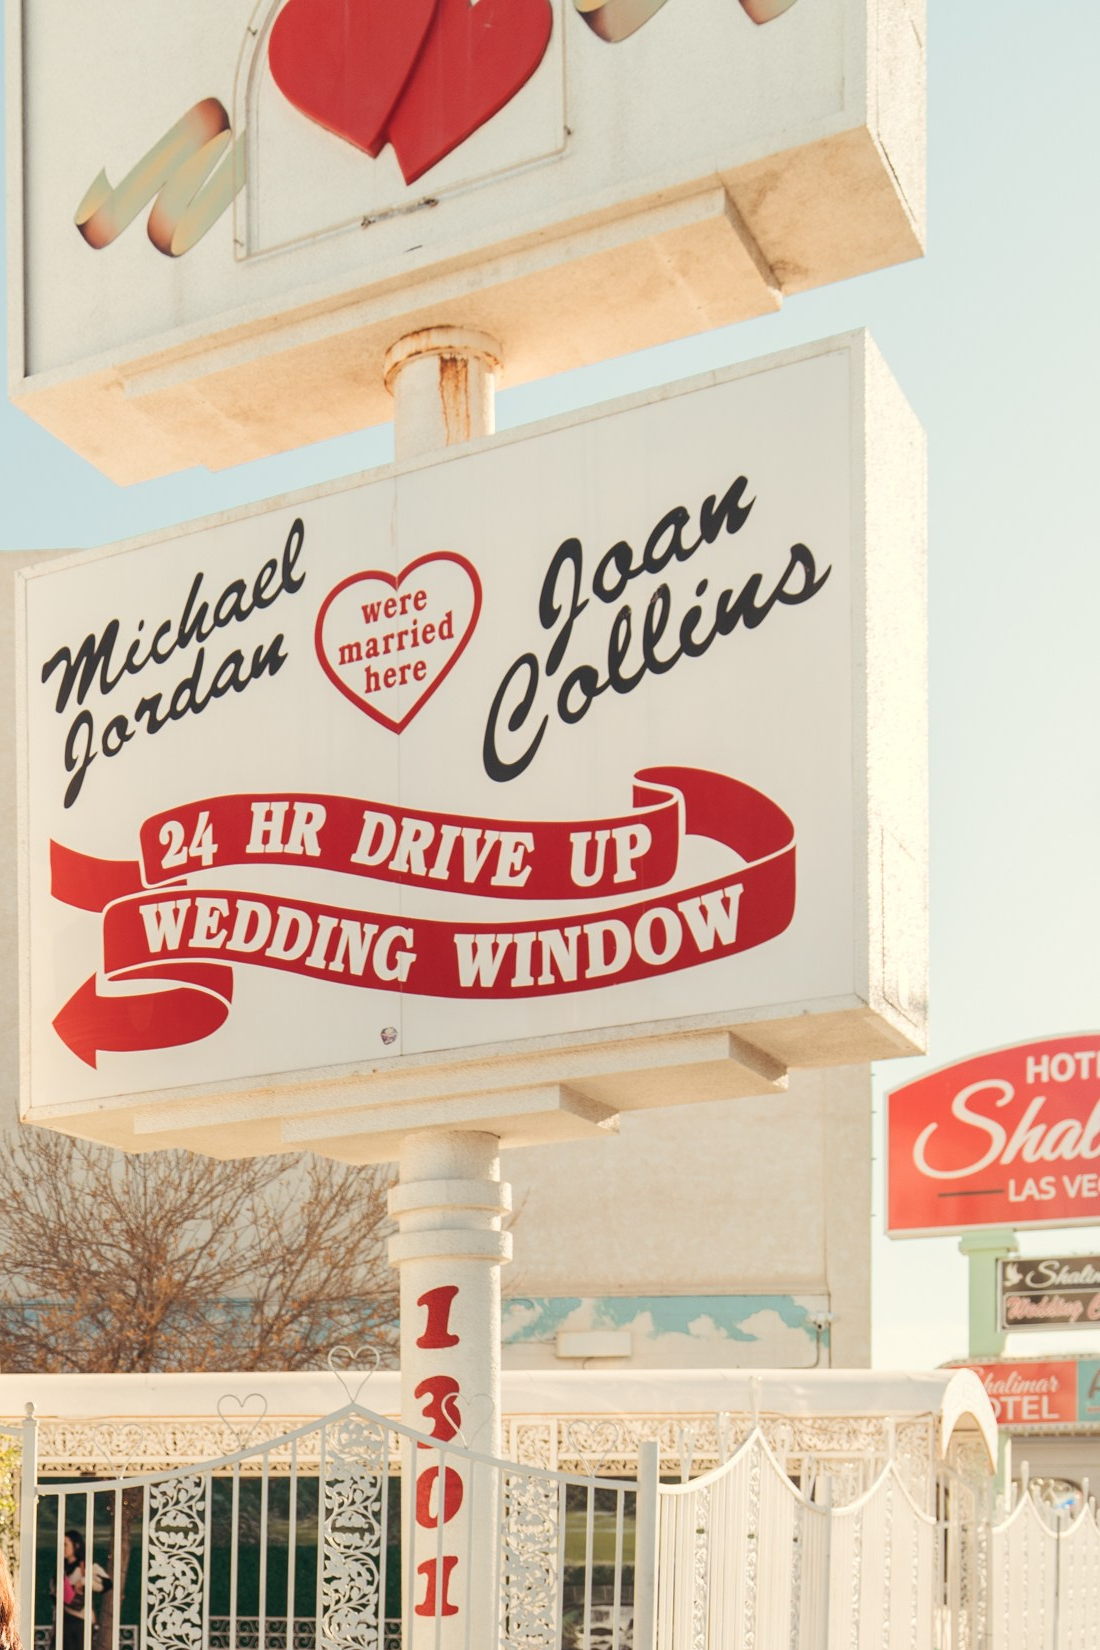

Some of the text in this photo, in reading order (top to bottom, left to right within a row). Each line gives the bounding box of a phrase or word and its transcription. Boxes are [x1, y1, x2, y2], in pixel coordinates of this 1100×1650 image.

[41, 518, 306, 714] Michael
[361, 589, 428, 625] were
[538, 475, 757, 677] Joan
[338, 610, 455, 665] married
[364, 660, 427, 694] here
[481, 542, 832, 783] Collins
[63, 633, 289, 809] Jordan
[158, 801, 652, 887] 24 HR DRIVE UP
[138, 883, 744, 988] WEDDING WINDOW
[1025, 1050, 1100, 1085] HOT
[1008, 1172, 1100, 1202] LAS VE
[971, 1365, 1059, 1396] halimar
[413, 1284, 465, 1618] 1301
